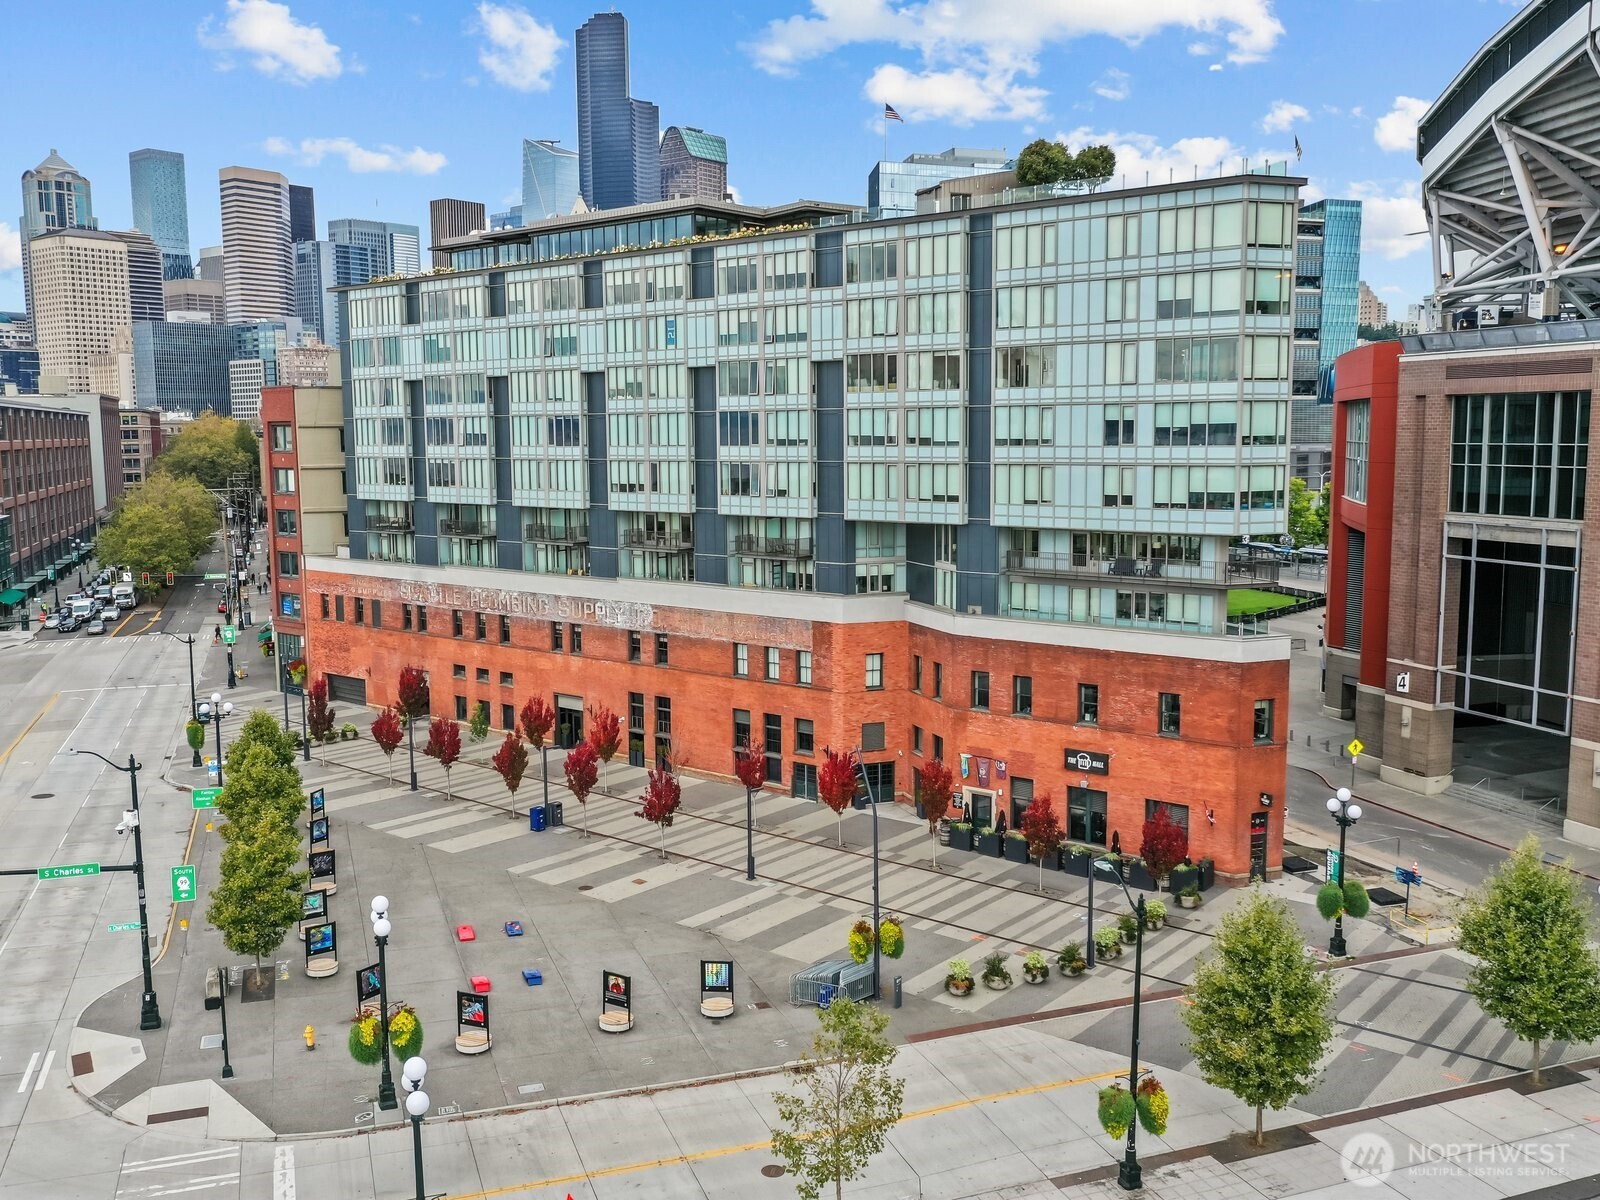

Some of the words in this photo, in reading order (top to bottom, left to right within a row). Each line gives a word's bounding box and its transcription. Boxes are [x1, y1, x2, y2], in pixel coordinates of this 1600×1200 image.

[1398, 676, 1407, 690] 4
[44, 870, 50, 878] S
[53, 867, 84, 877] Charles
